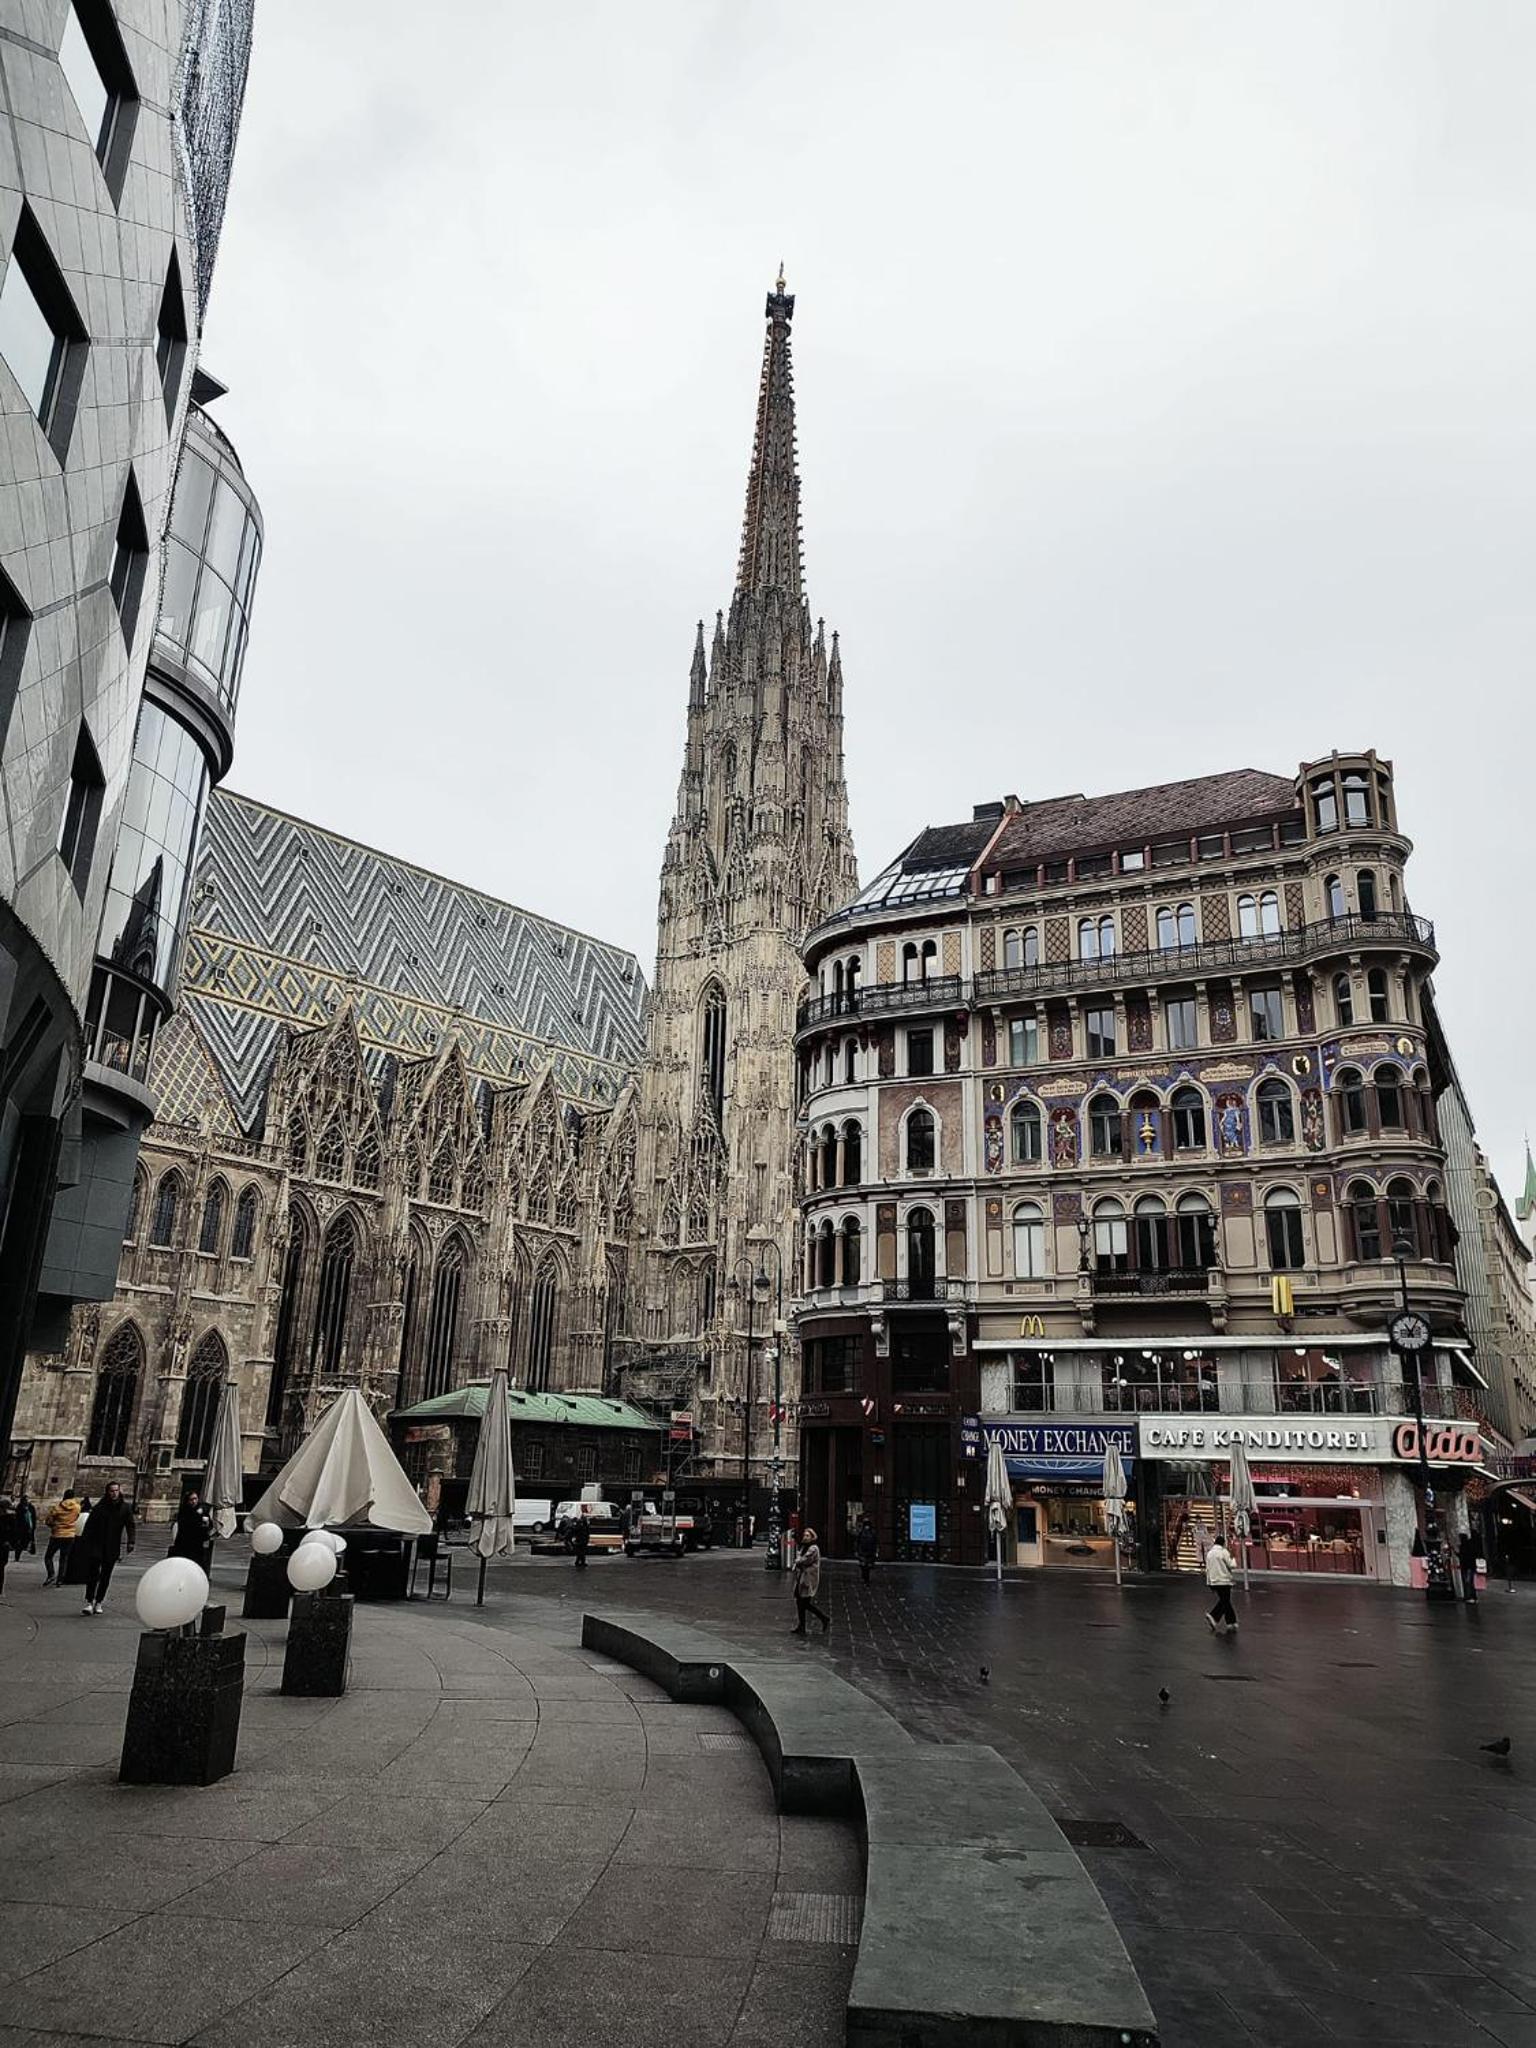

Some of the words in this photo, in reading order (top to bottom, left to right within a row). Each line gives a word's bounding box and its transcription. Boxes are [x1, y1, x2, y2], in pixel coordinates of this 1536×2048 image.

[983, 1428, 1040, 1452] MONEY
[1044, 1429, 1133, 1454] EXCHANGE
[1149, 1429, 1205, 1447] CAFE
[1213, 1430, 1369, 1449] KONDITOREI
[1031, 1485, 1067, 1496] MONEY
[1069, 1486, 1105, 1497] CHANG
